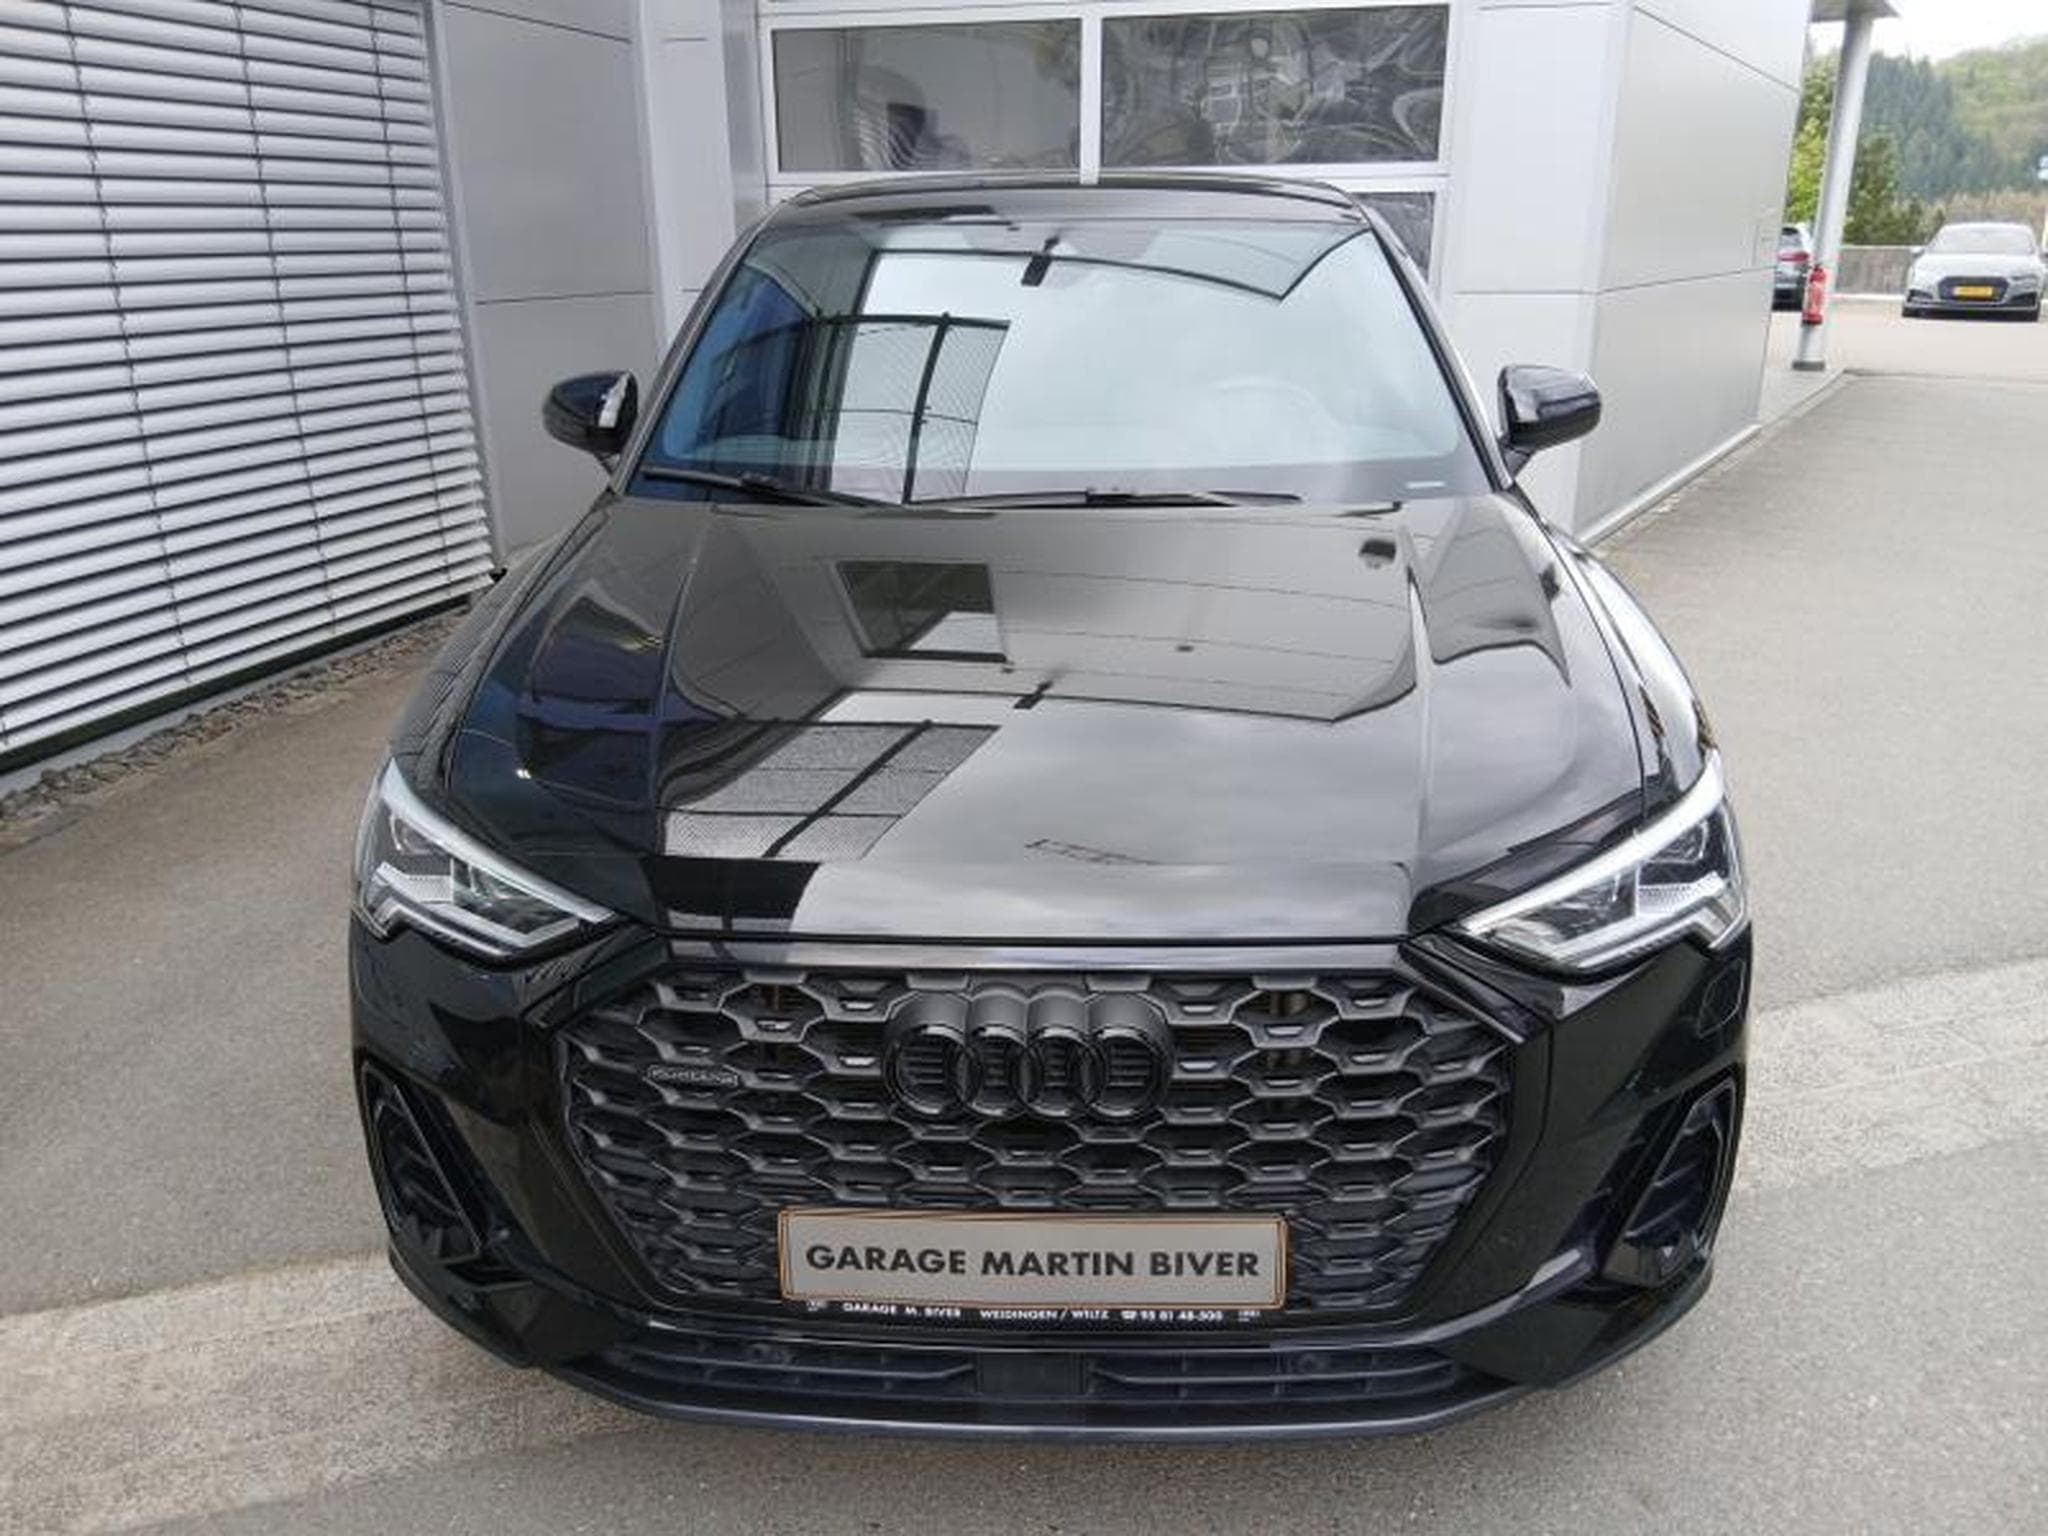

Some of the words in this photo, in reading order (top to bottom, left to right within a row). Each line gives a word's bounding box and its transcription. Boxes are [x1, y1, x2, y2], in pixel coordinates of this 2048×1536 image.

[806, 1245, 966, 1275] GARAGE
[981, 1250, 1134, 1277] MARTIN
[1150, 1251, 1259, 1277] BIVER
[842, 1301, 898, 1315] GARAGE
